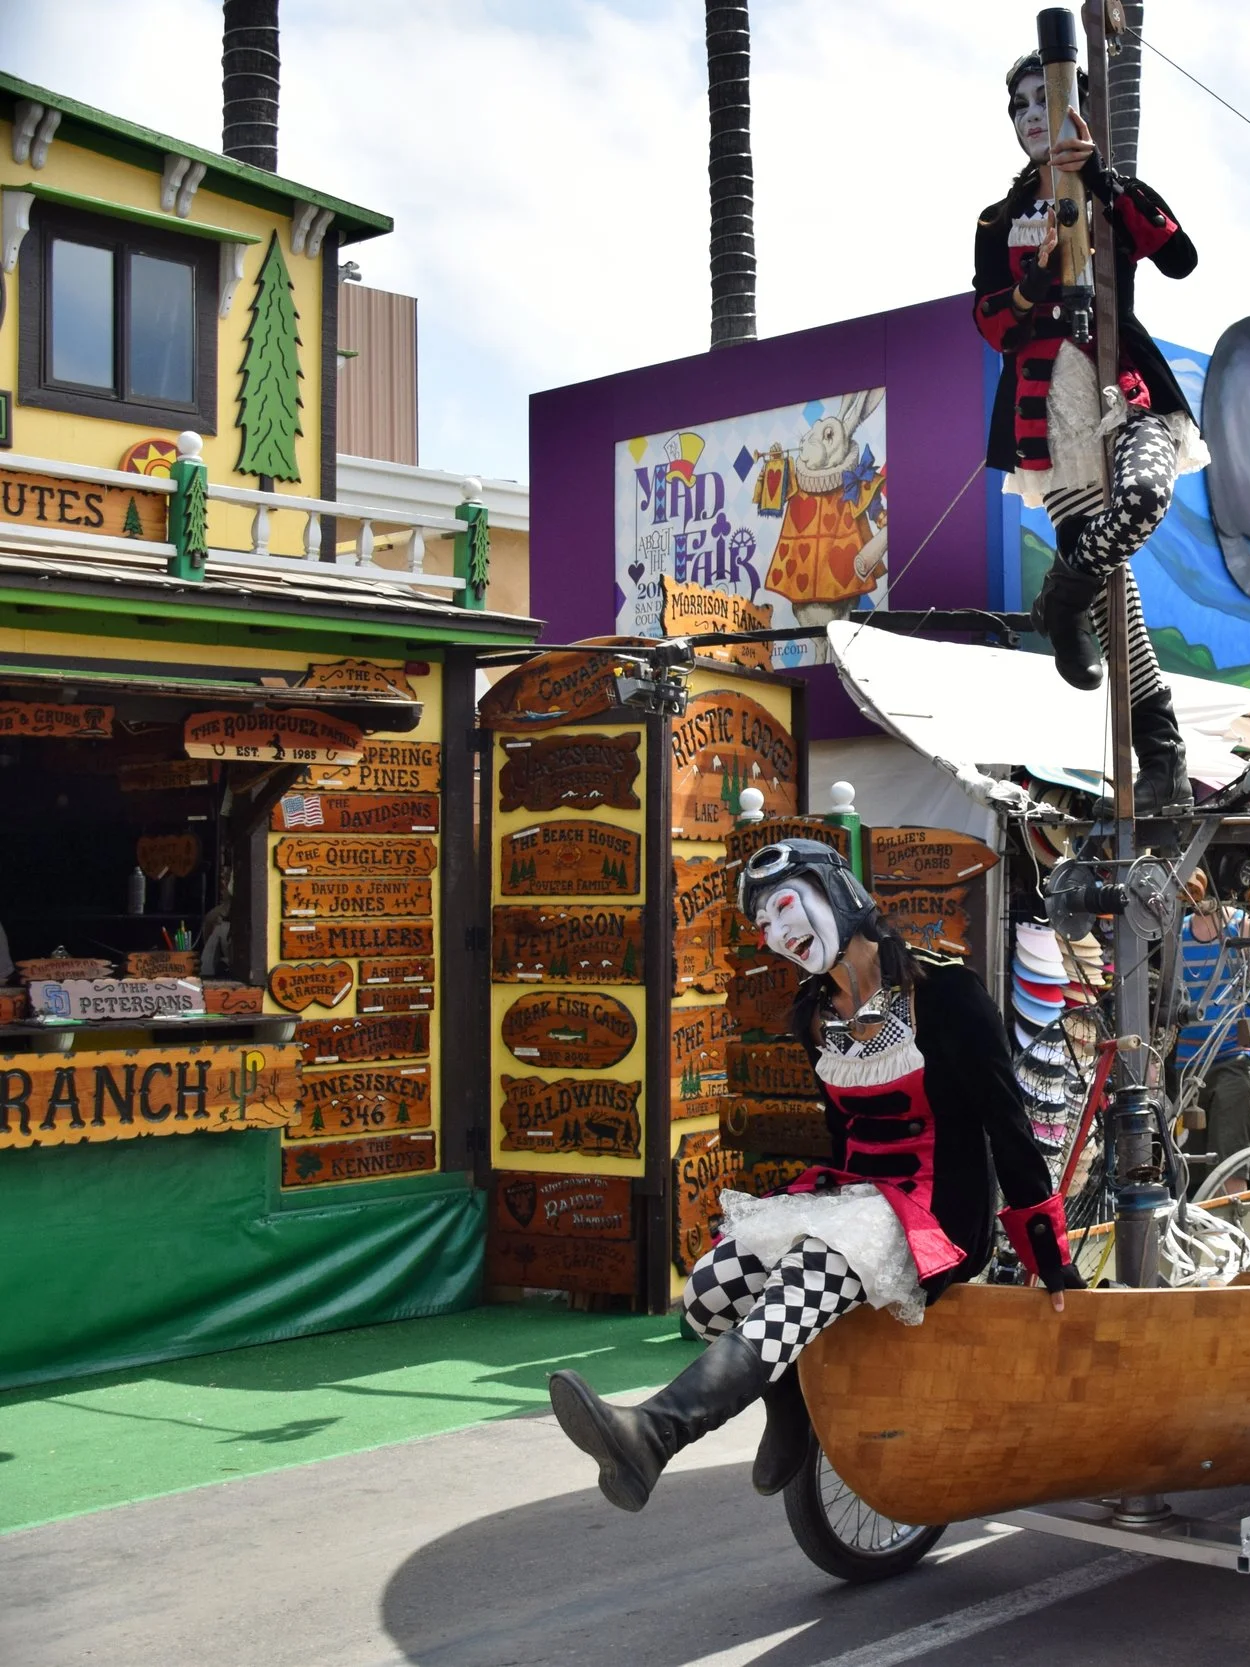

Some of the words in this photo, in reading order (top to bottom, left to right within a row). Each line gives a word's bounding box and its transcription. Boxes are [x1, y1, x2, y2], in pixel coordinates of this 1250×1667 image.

[2, 481, 104, 528] UTES
[634, 462, 725, 534] MAD
[638, 527, 674, 559] ABOUT
[646, 550, 667, 575] THE
[673, 526, 761, 601] FAIR
[637, 581, 661, 600] 201
[635, 602, 653, 614] SAN
[655, 600, 662, 612] D
[671, 592, 729, 620] MORRISON
[635, 613, 660, 626] COUN
[773, 642, 808, 657] ir.com
[346, 669, 370, 681] THE
[34, 709, 81, 728] GRUBB
[191, 720, 220, 740] THE
[223, 712, 319, 739] RODRIGUEZ
[321, 724, 358, 749] FAMILY
[672, 707, 733, 771] RUSTIC
[236, 747, 260, 758] EST.
[293, 749, 317, 760] 1985
[360, 766, 420, 788] PINES
[327, 799, 349, 810] THE
[340, 802, 432, 828] DAVIDSONS
[694, 803, 719, 823] LAKE
[509, 834, 538, 854] THE
[542, 828, 584, 843] BEACH
[588, 829, 631, 855] HOUSE
[876, 832, 926, 853] BILLIE'S
[296, 849, 320, 862] THE
[326, 847, 417, 866] QUIGLEYS
[887, 843, 953, 867] BACKYARD
[914, 857, 951, 872] OASIS
[311, 883, 349, 894] DAVID
[355, 885, 362, 894] &
[367, 882, 410, 894] JENNY
[577, 878, 612, 890] FAMILY
[329, 896, 385, 912] JONES
[680, 868, 728, 927] DESER
[296, 931, 322, 945] THE
[327, 927, 424, 949] MILLERS
[514, 912, 625, 957] PETERSON
[118, 983, 149, 994] THE
[289, 973, 327, 987] JAMES
[735, 969, 789, 1005] POINT
[295, 985, 337, 998] RACHEL
[79, 995, 193, 1016] PETERSONS
[556, 997, 589, 1018] FISH
[592, 1005, 630, 1038] CAMP
[673, 1021, 704, 1061] THE
[776, 1045, 807, 1065] THE
[753, 1065, 815, 1089] MILLE
[0, 1060, 212, 1136] RANCH
[512, 1085, 535, 1099] THE
[340, 1103, 386, 1128] 346
[517, 1084, 628, 1129] BALDWINS
[781, 1102, 801, 1113] THE
[367, 1140, 393, 1153] THE
